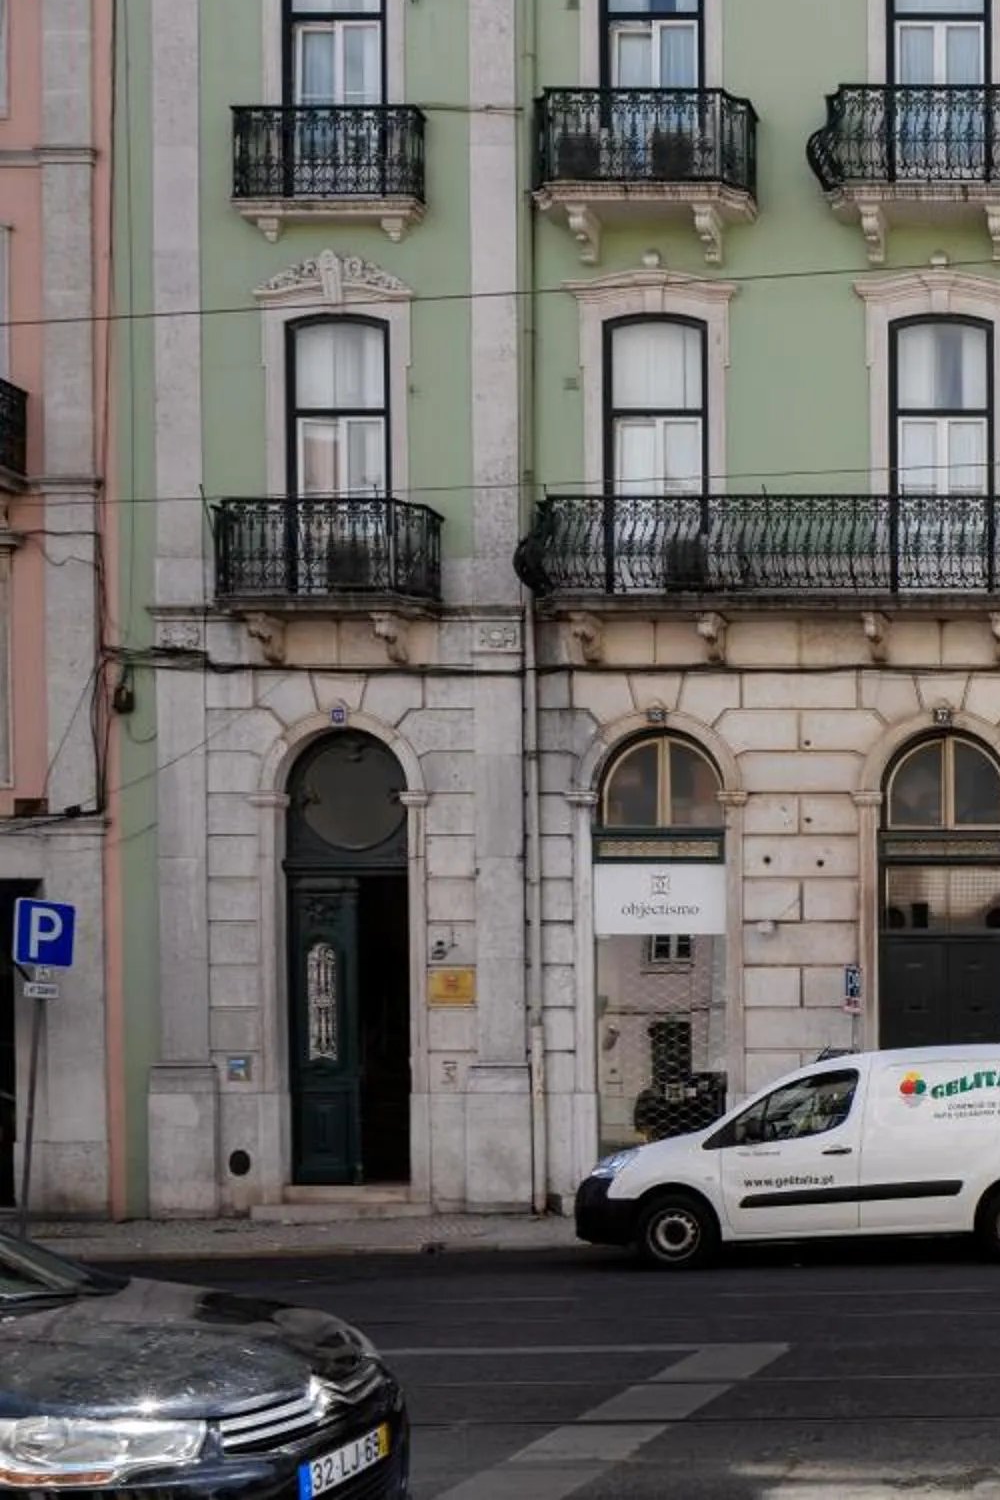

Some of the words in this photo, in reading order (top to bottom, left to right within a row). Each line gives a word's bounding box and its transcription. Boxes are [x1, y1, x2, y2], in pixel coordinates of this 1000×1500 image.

[621, 902, 700, 919] objectismo
[29, 907, 63, 959] P
[743, 1174, 834, 1188] www.gelitalia.pt
